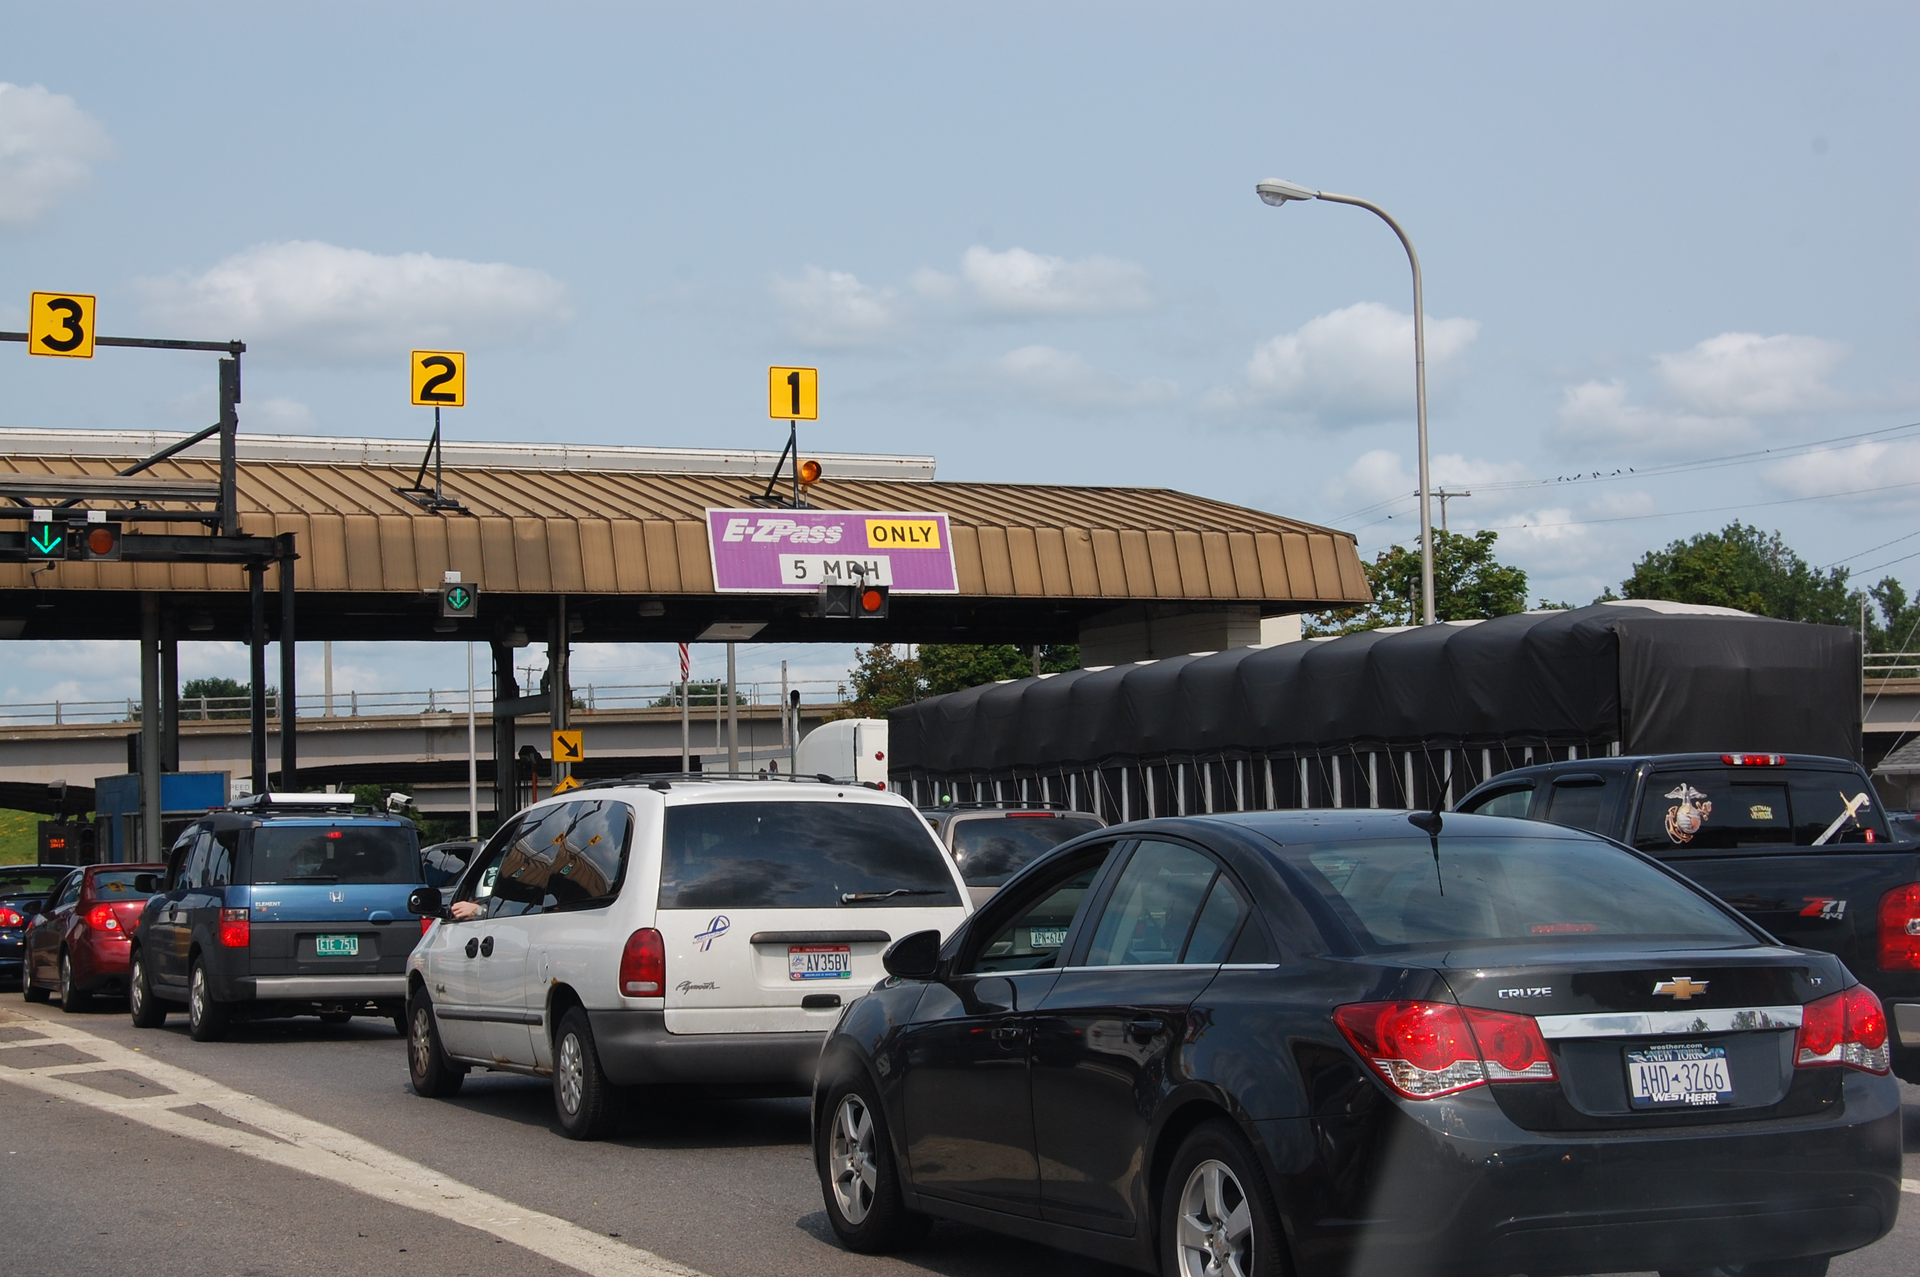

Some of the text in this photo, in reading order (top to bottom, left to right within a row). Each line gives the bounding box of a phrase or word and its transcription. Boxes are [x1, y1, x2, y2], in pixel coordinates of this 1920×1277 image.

[40, 297, 85, 352] 3
[420, 355, 457, 402] 2
[787, 371, 800, 415] 1
[722, 518, 932, 545] E-ZPass ONLY
[793, 560, 879, 580] 5 MPH
[1799, 897, 1848, 917] Z71
[340, 939, 355, 951] 751
[806, 954, 849, 971] AV35BV
[1810, 977, 1822, 987] LT
[1498, 986, 1552, 999] CRUZE
[1650, 1043, 1703, 1051] westherr.com
[1650, 1049, 1703, 1062] NEW YORK
